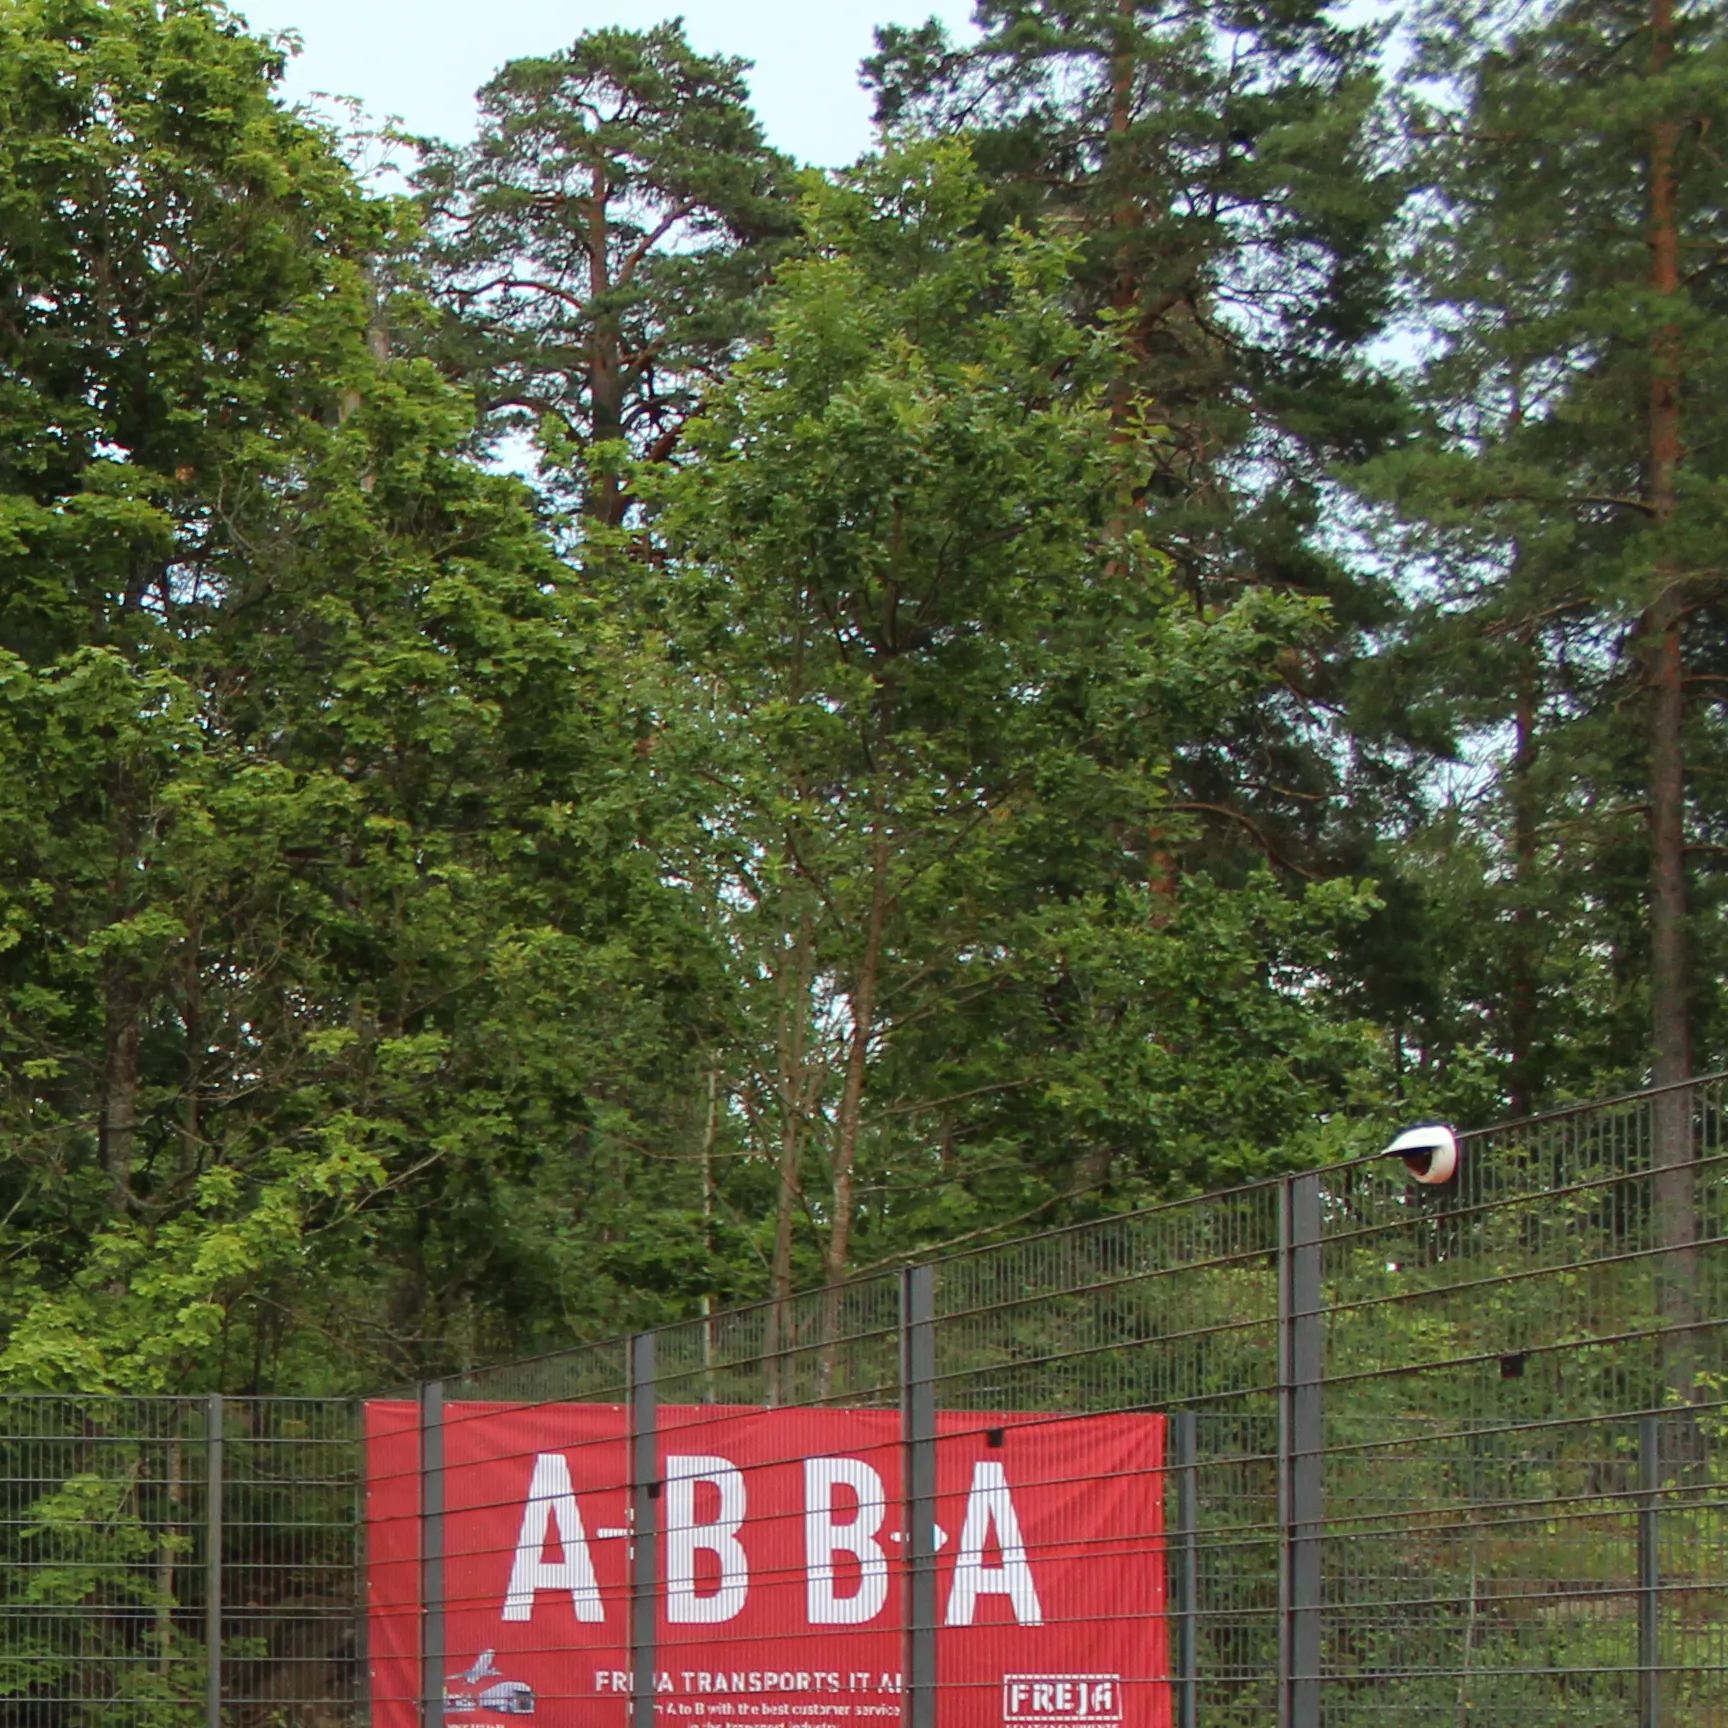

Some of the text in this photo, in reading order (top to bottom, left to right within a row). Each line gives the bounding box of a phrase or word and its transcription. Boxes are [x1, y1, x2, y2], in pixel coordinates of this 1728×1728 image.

[502, 1454, 1044, 1626] A B B A
[681, 1671, 840, 1693] TRANSPORTS
[850, 1672, 871, 1693] IT
[1011, 1682, 1112, 1715] FREJA
